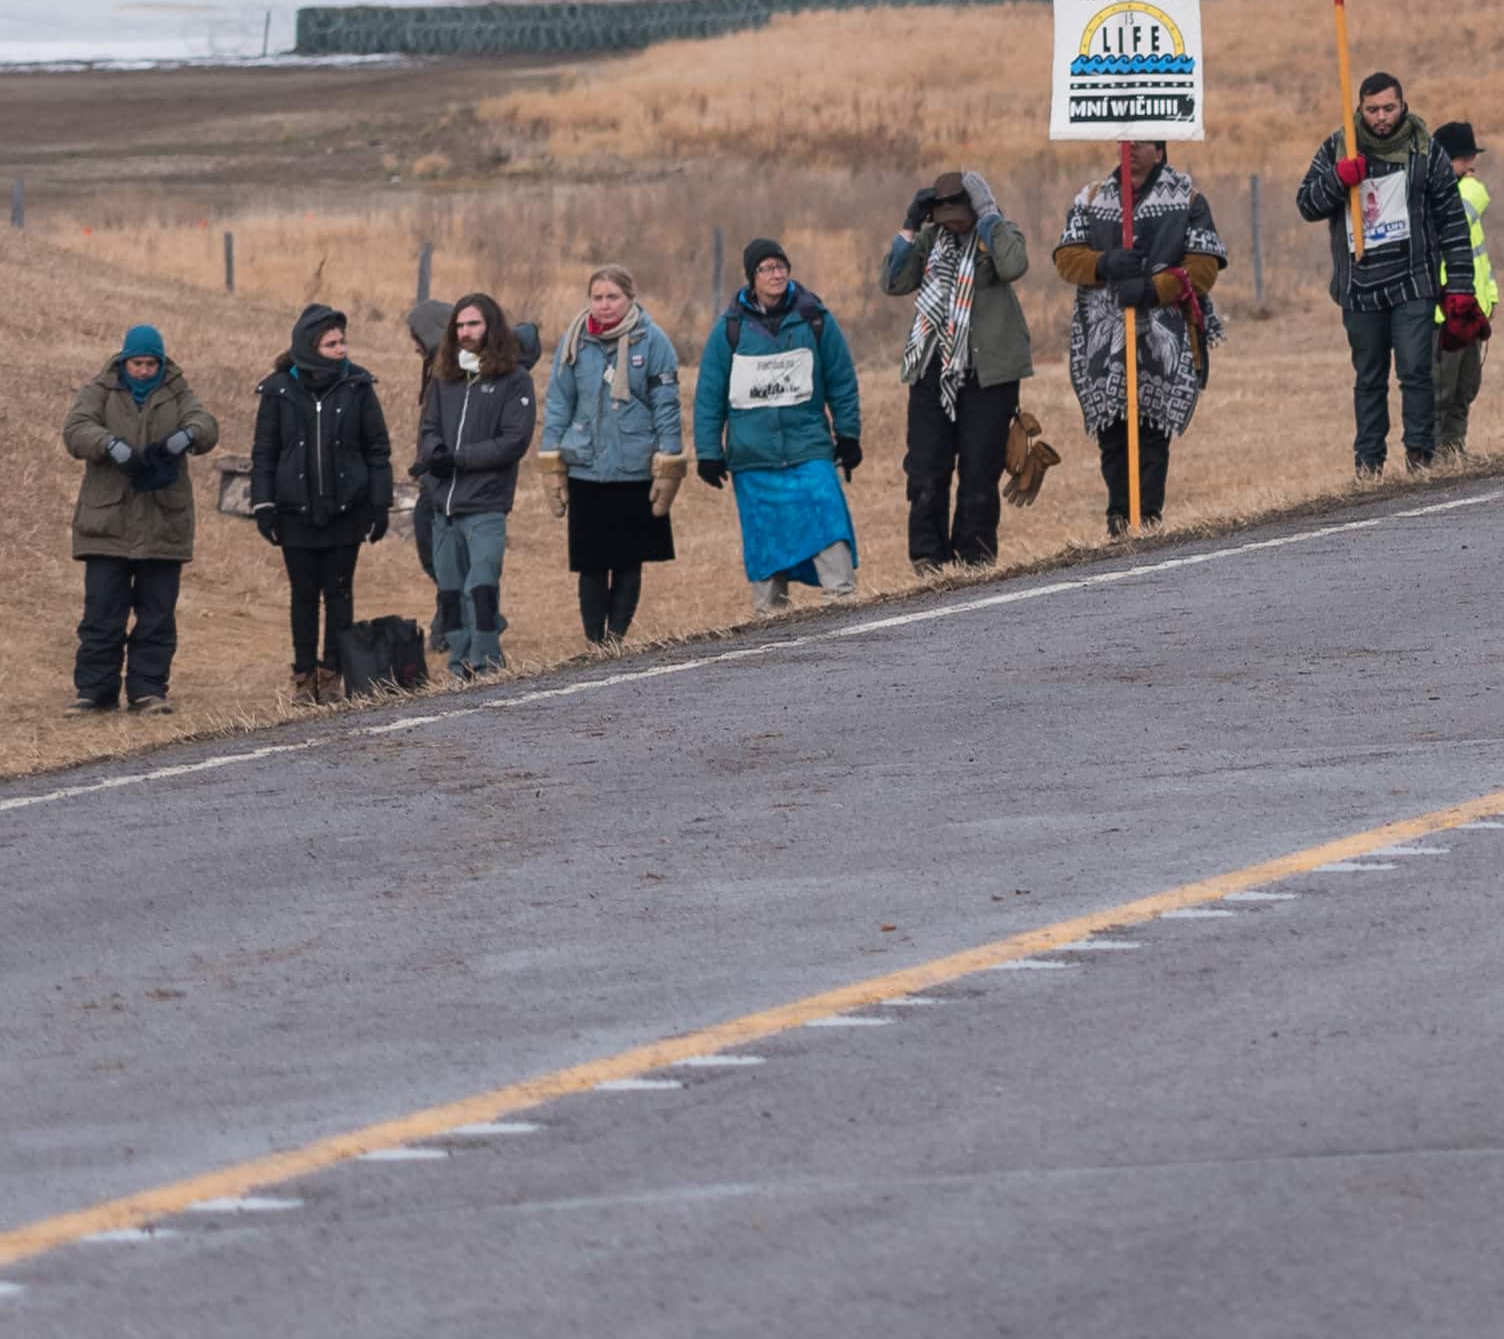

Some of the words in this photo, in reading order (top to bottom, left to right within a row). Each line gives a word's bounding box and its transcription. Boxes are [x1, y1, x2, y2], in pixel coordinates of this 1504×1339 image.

[1124, 13, 1134, 26] IS
[1102, 26, 1160, 53] LIFE
[1070, 97, 1109, 117] MNÍ
